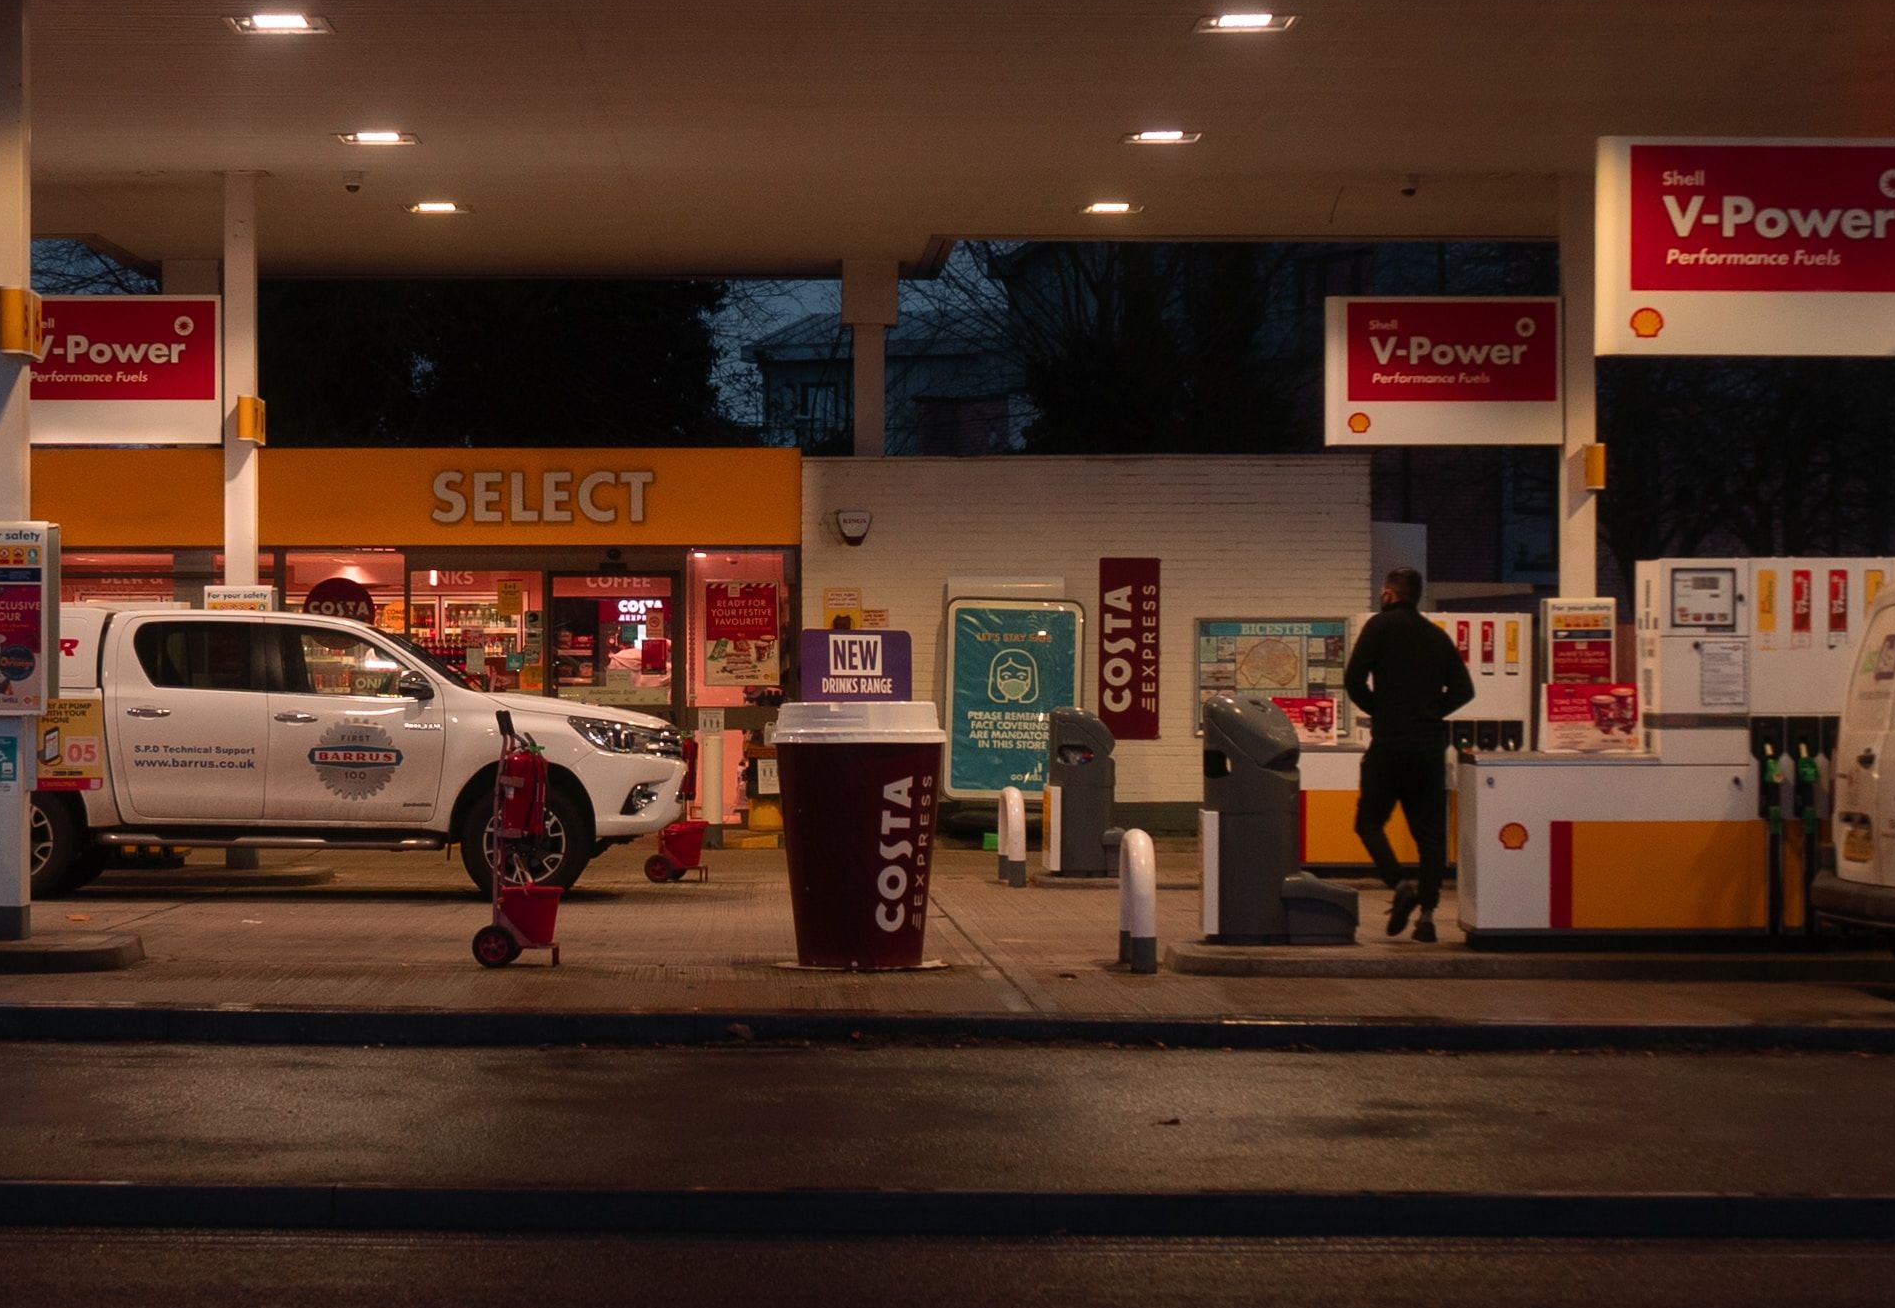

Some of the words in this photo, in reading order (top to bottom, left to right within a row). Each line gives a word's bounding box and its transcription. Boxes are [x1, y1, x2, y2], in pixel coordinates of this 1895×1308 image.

[1661, 169, 1706, 187] Shell
[1665, 248, 1790, 267] Performance
[1793, 248, 1842, 267] Fuels
[41, 318, 55, 329] ell
[1368, 319, 1399, 331] Shell
[1368, 335, 1529, 366] V-Power
[30, 370, 113, 383] Performance
[115, 370, 149, 383] Fuels
[1371, 372, 1456, 384] Performance
[1458, 372, 1491, 384] Fuels
[431, 470, 654, 523] SELECT
[5, 530, 41, 542] safety
[585, 576, 652, 588] COFFEE
[222, 593, 241, 601] your
[242, 592, 268, 601] safety
[307, 600, 370, 617] COSTA
[617, 599, 664, 614] COSTA
[716, 599, 746, 607] READY
[747, 599, 766, 607] FOR
[710, 608, 737, 617] YOUR
[738, 608, 772, 617] FESTIVE
[715, 617, 769, 626] FAVOURITE?
[1240, 623, 1313, 635] BICESTER
[1141, 584, 1157, 693] EXPRESS
[1102, 584, 1137, 713] COSTA
[833, 639, 878, 671] NEW
[821, 677, 859, 694] DRINKS
[859, 677, 893, 694] RANGE
[967, 711, 1003, 720] PLEASE
[970, 721, 995, 730] FACE
[996, 720, 1050, 730] COVERING
[340, 734, 371, 742] FIRST
[969, 730, 989, 740] ARE
[990, 730, 1050, 740] MANDATOR
[134, 745, 160, 754] S.P.D
[163, 745, 213, 754] Technical
[215, 746, 255, 756] Support
[978, 740, 990, 749] IN
[992, 740, 1014, 749] THIS
[1016, 740, 1048, 749] STORE
[67, 743, 97, 763] 05
[318, 751, 393, 762] BARRUS
[134, 758, 255, 770] www.barrus.co.uk
[344, 771, 367, 780] 100
[913, 774, 933, 907] EXPRESS
[875, 775, 914, 933] COSTA
